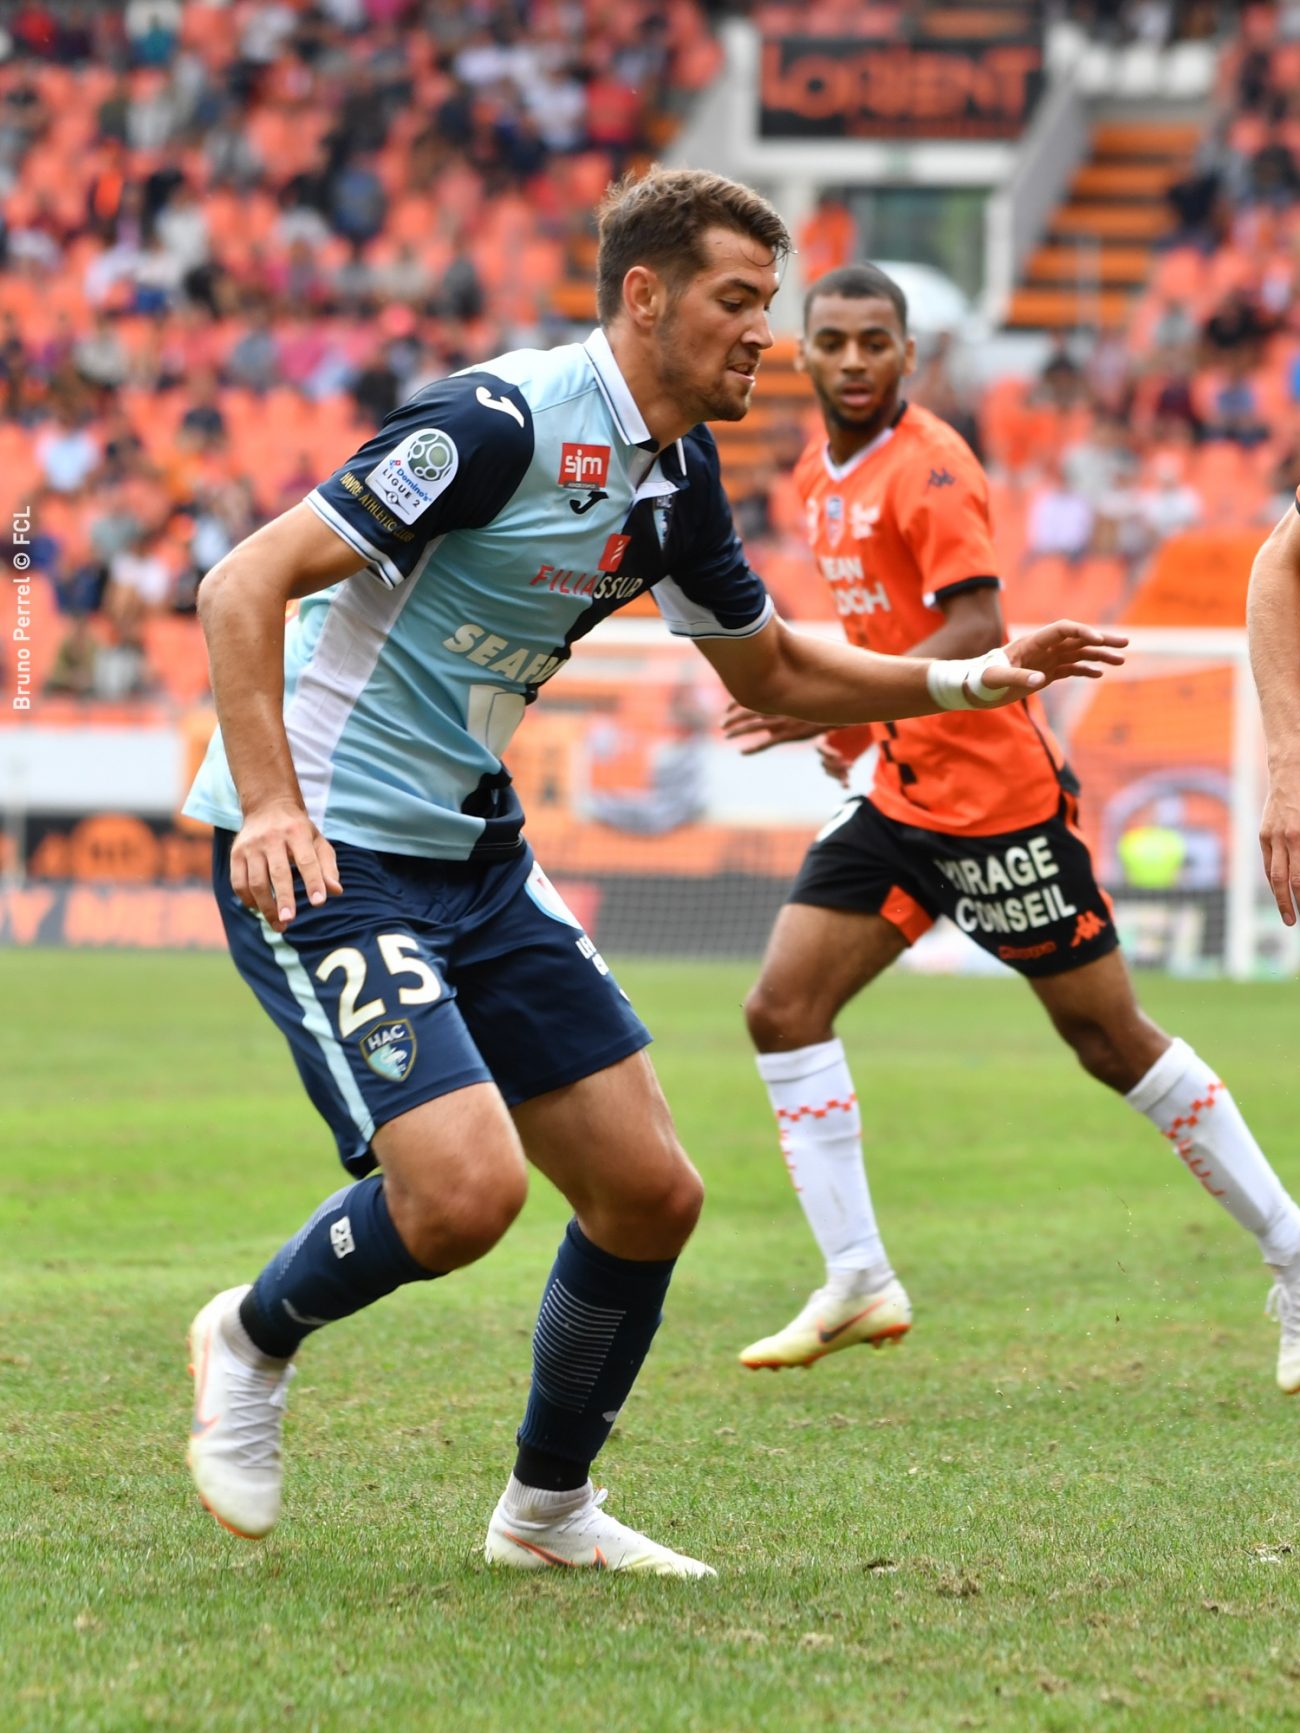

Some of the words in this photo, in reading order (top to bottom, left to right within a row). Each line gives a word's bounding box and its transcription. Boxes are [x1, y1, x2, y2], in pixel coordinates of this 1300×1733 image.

[339, 472, 364, 497] HAVRE
[358, 494, 397, 532] ATHLETIC
[382, 468, 412, 500] LIGUE
[412, 500, 421, 508] 2
[396, 467, 430, 502] Domino's
[934, 836, 1059, 896] VIRAGE
[955, 883, 1077, 933] CONSEIL
[315, 933, 442, 1039] 25
[368, 1024, 405, 1051] HAC
